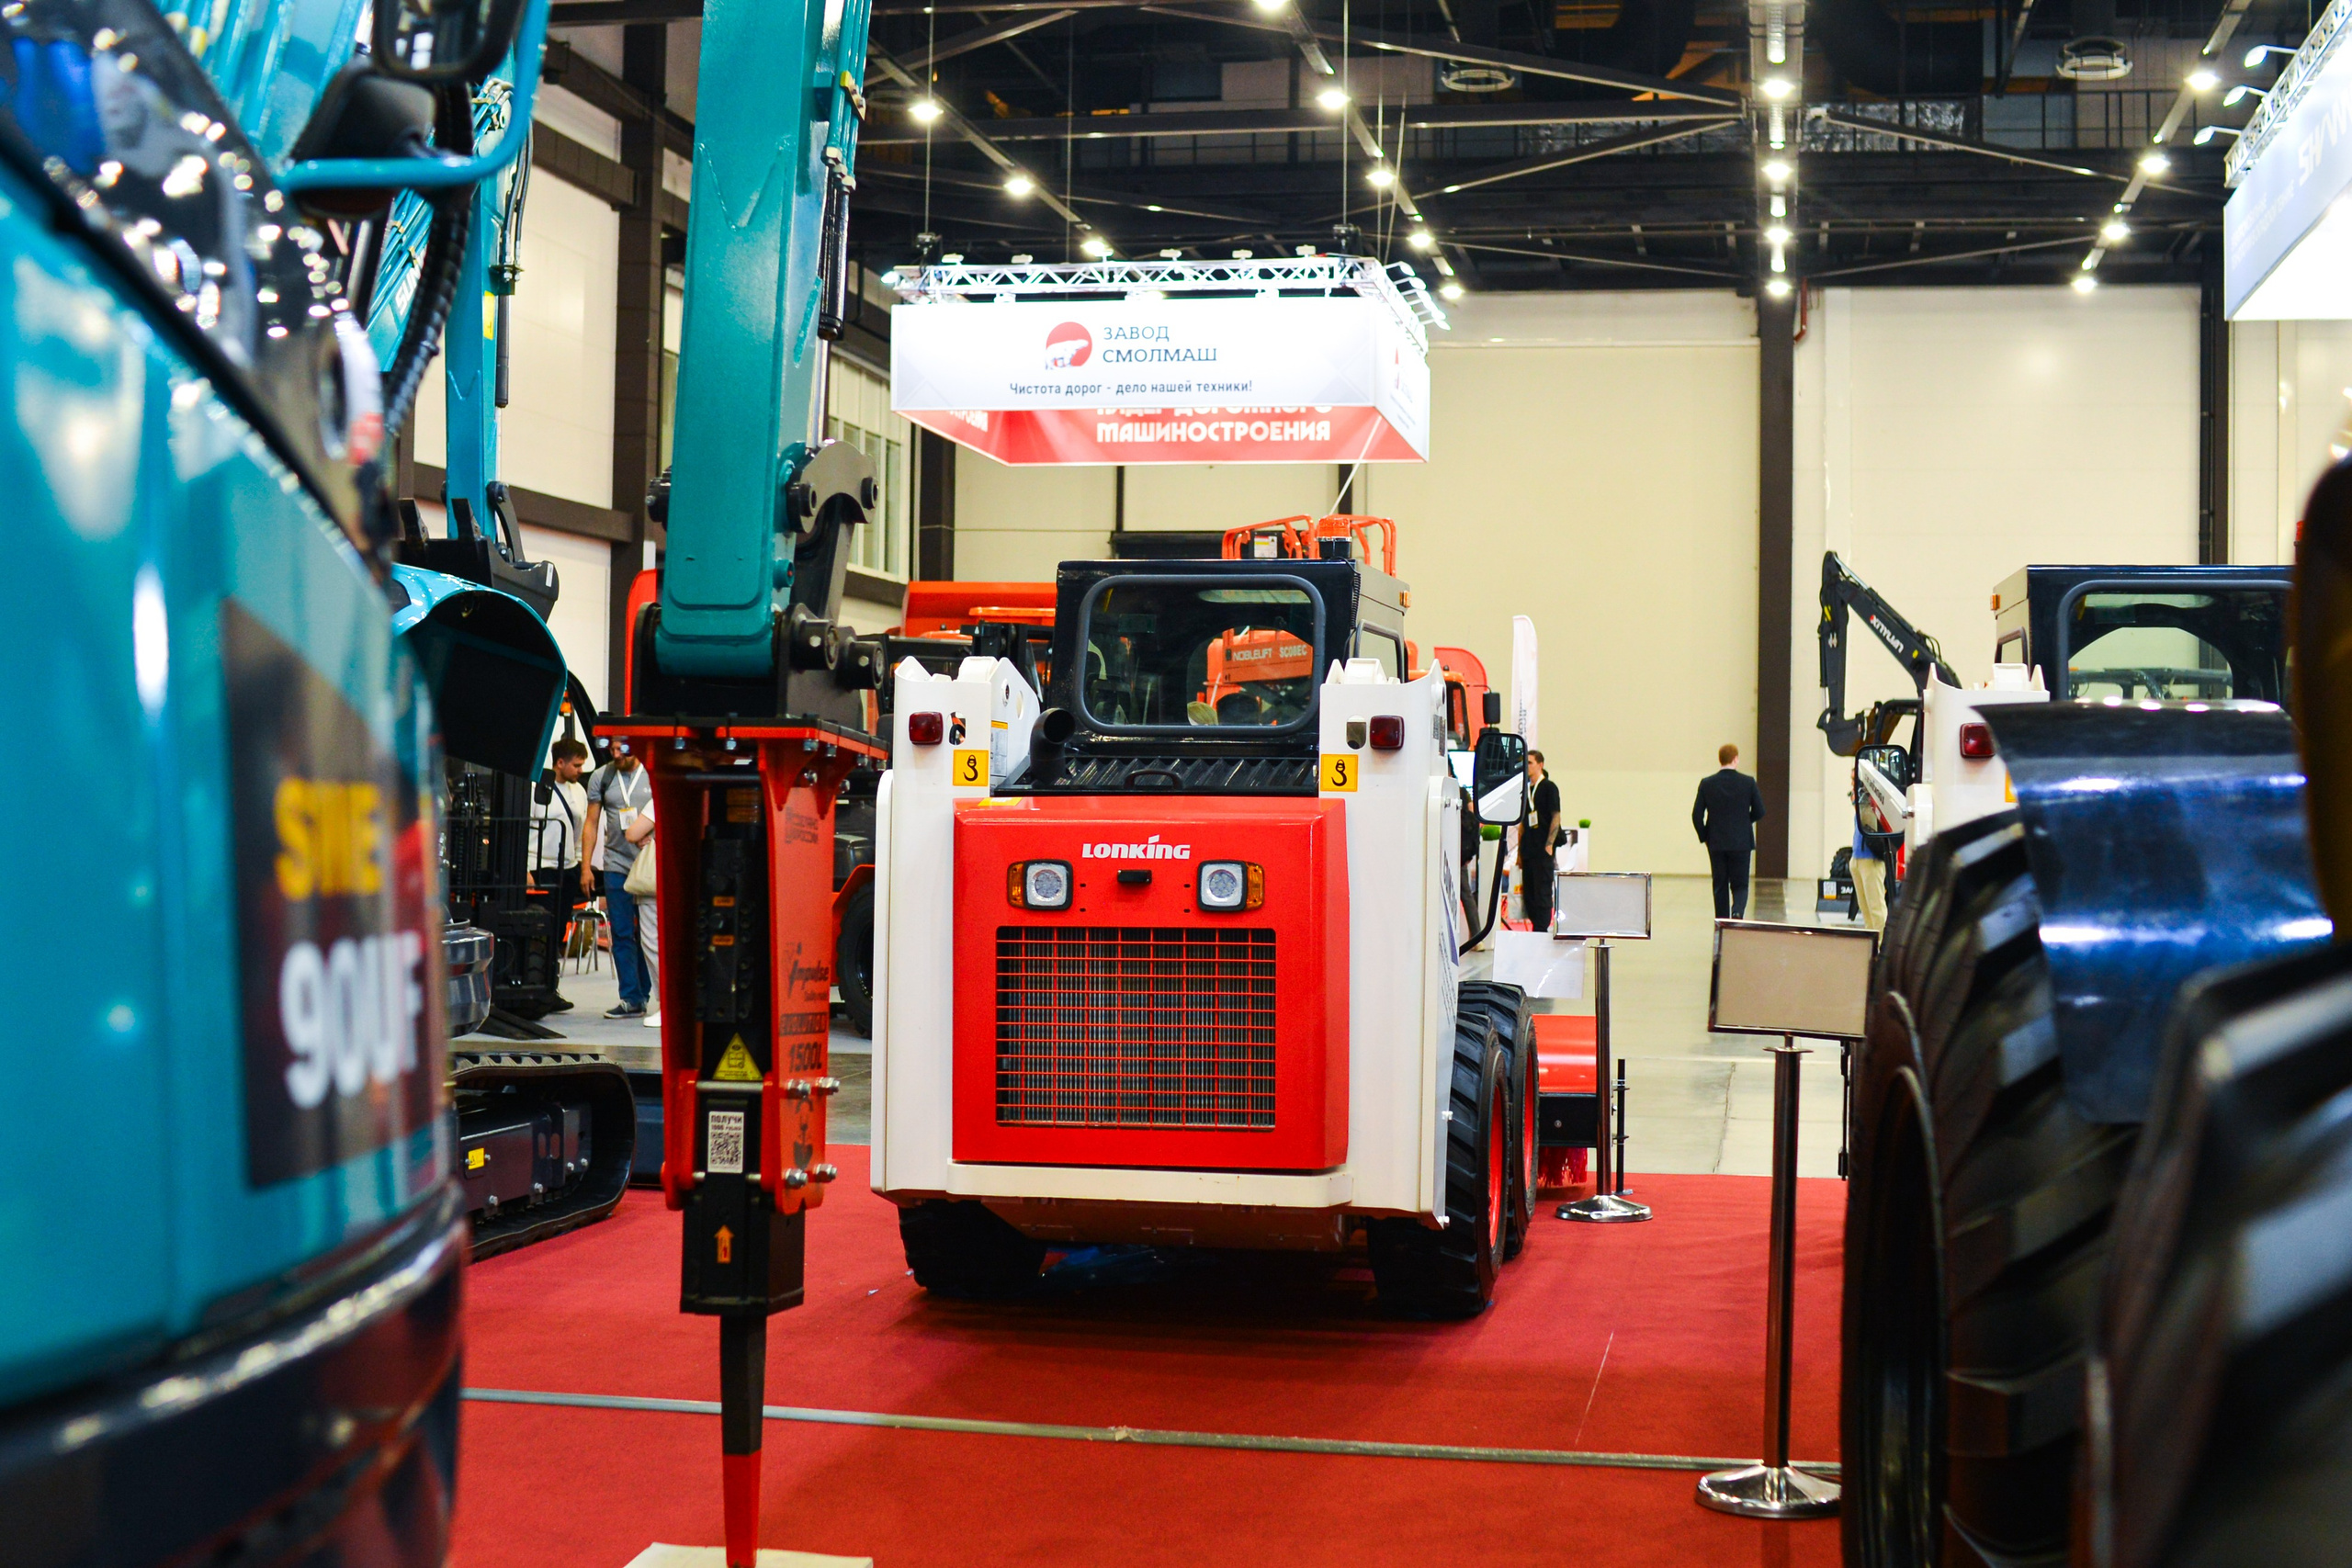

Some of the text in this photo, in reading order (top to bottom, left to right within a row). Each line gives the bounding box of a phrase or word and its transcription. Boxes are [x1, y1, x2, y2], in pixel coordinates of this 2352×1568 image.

[1103, 326, 1170, 342] ЗАВОД
[1102, 348, 1217, 363] СМОЛМАШ
[1010, 383, 1061, 394] Чистота
[1065, 384, 1102, 396] дорог
[1115, 383, 1147, 395] дело
[1151, 380, 1192, 393] нашей
[1196, 380, 1253, 392] техники!
[1097, 420, 1330, 443] МАШИНОСТРОЕНИЯ
